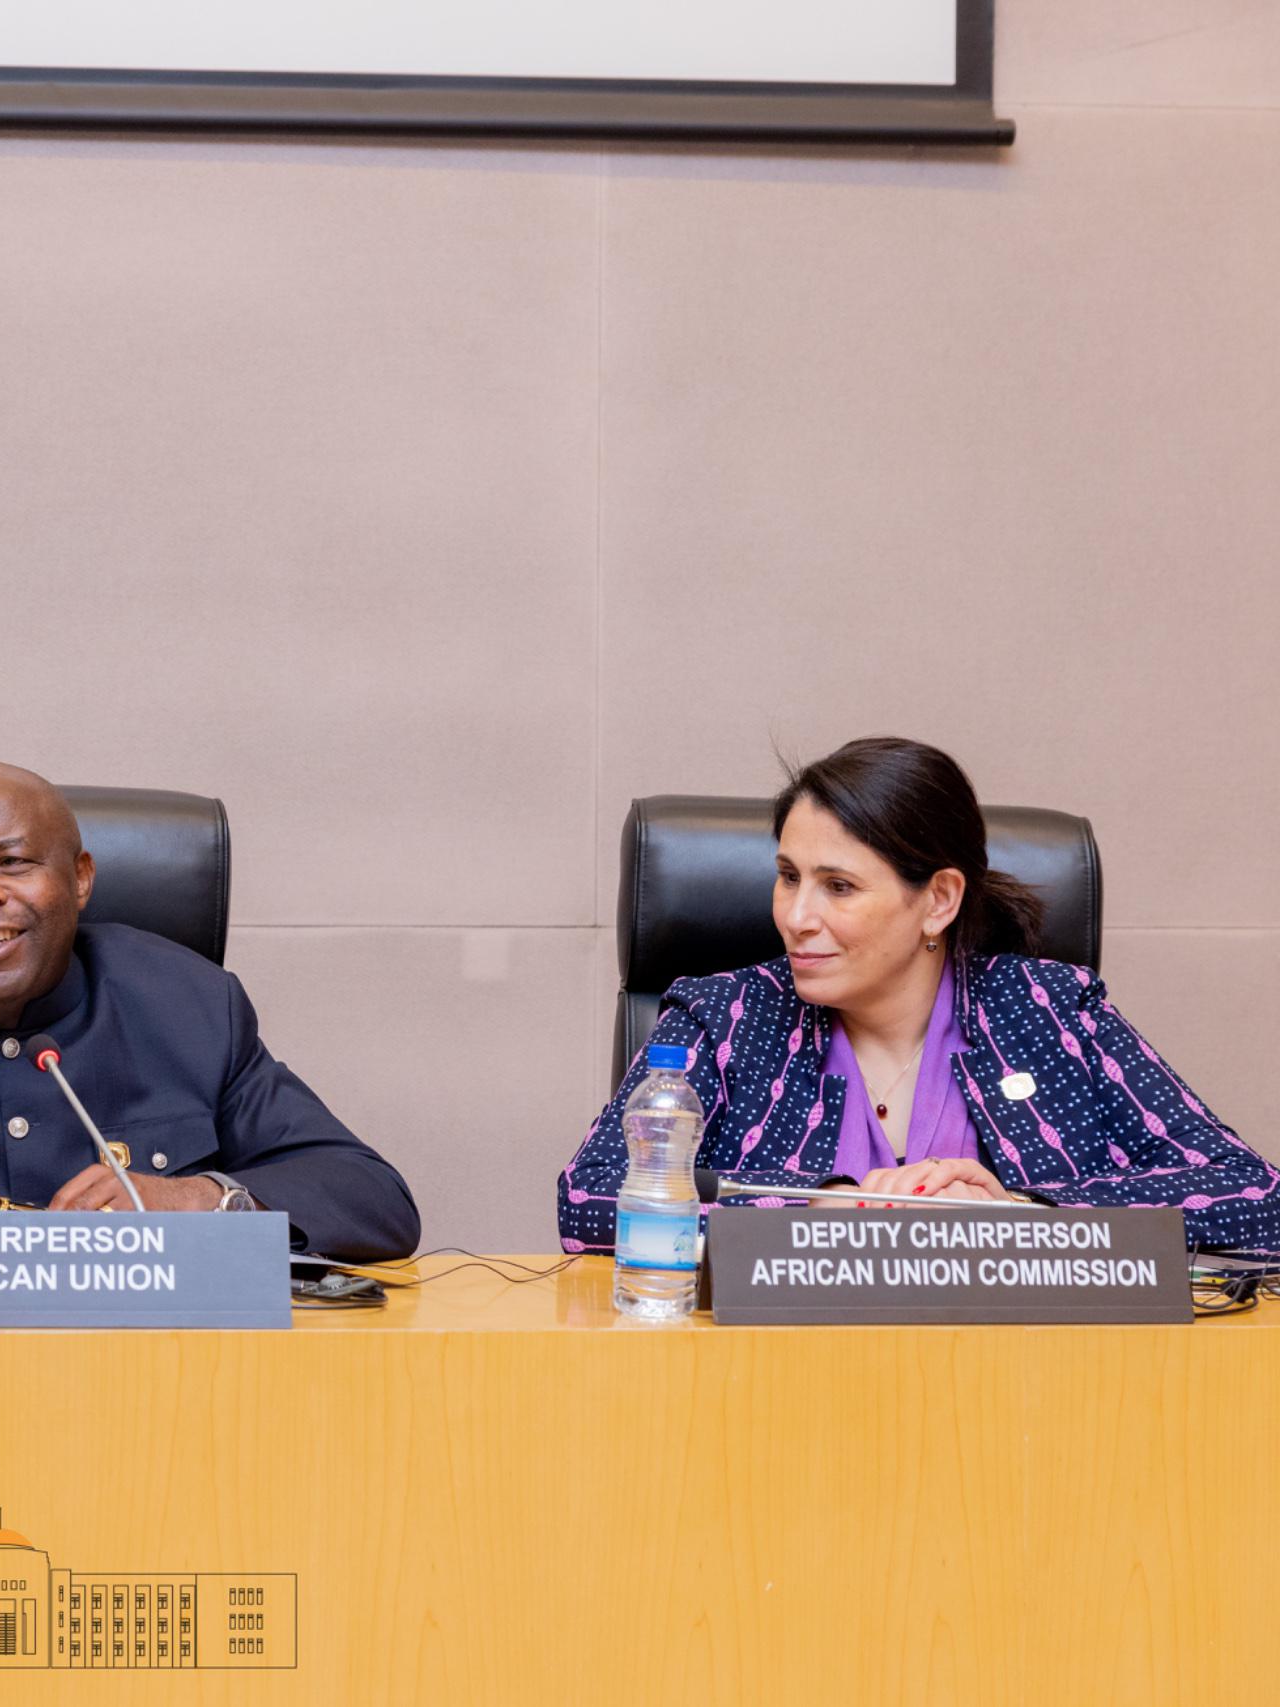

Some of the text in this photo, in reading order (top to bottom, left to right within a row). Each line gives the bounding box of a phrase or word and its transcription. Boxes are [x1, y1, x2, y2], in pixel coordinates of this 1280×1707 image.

[791, 1221, 1111, 1249] DEPUTY CHAIRPERSON
[69, 1263, 175, 1291] UNION
[751, 1258, 1157, 1287] AFRICAN UNION COMMISSION
